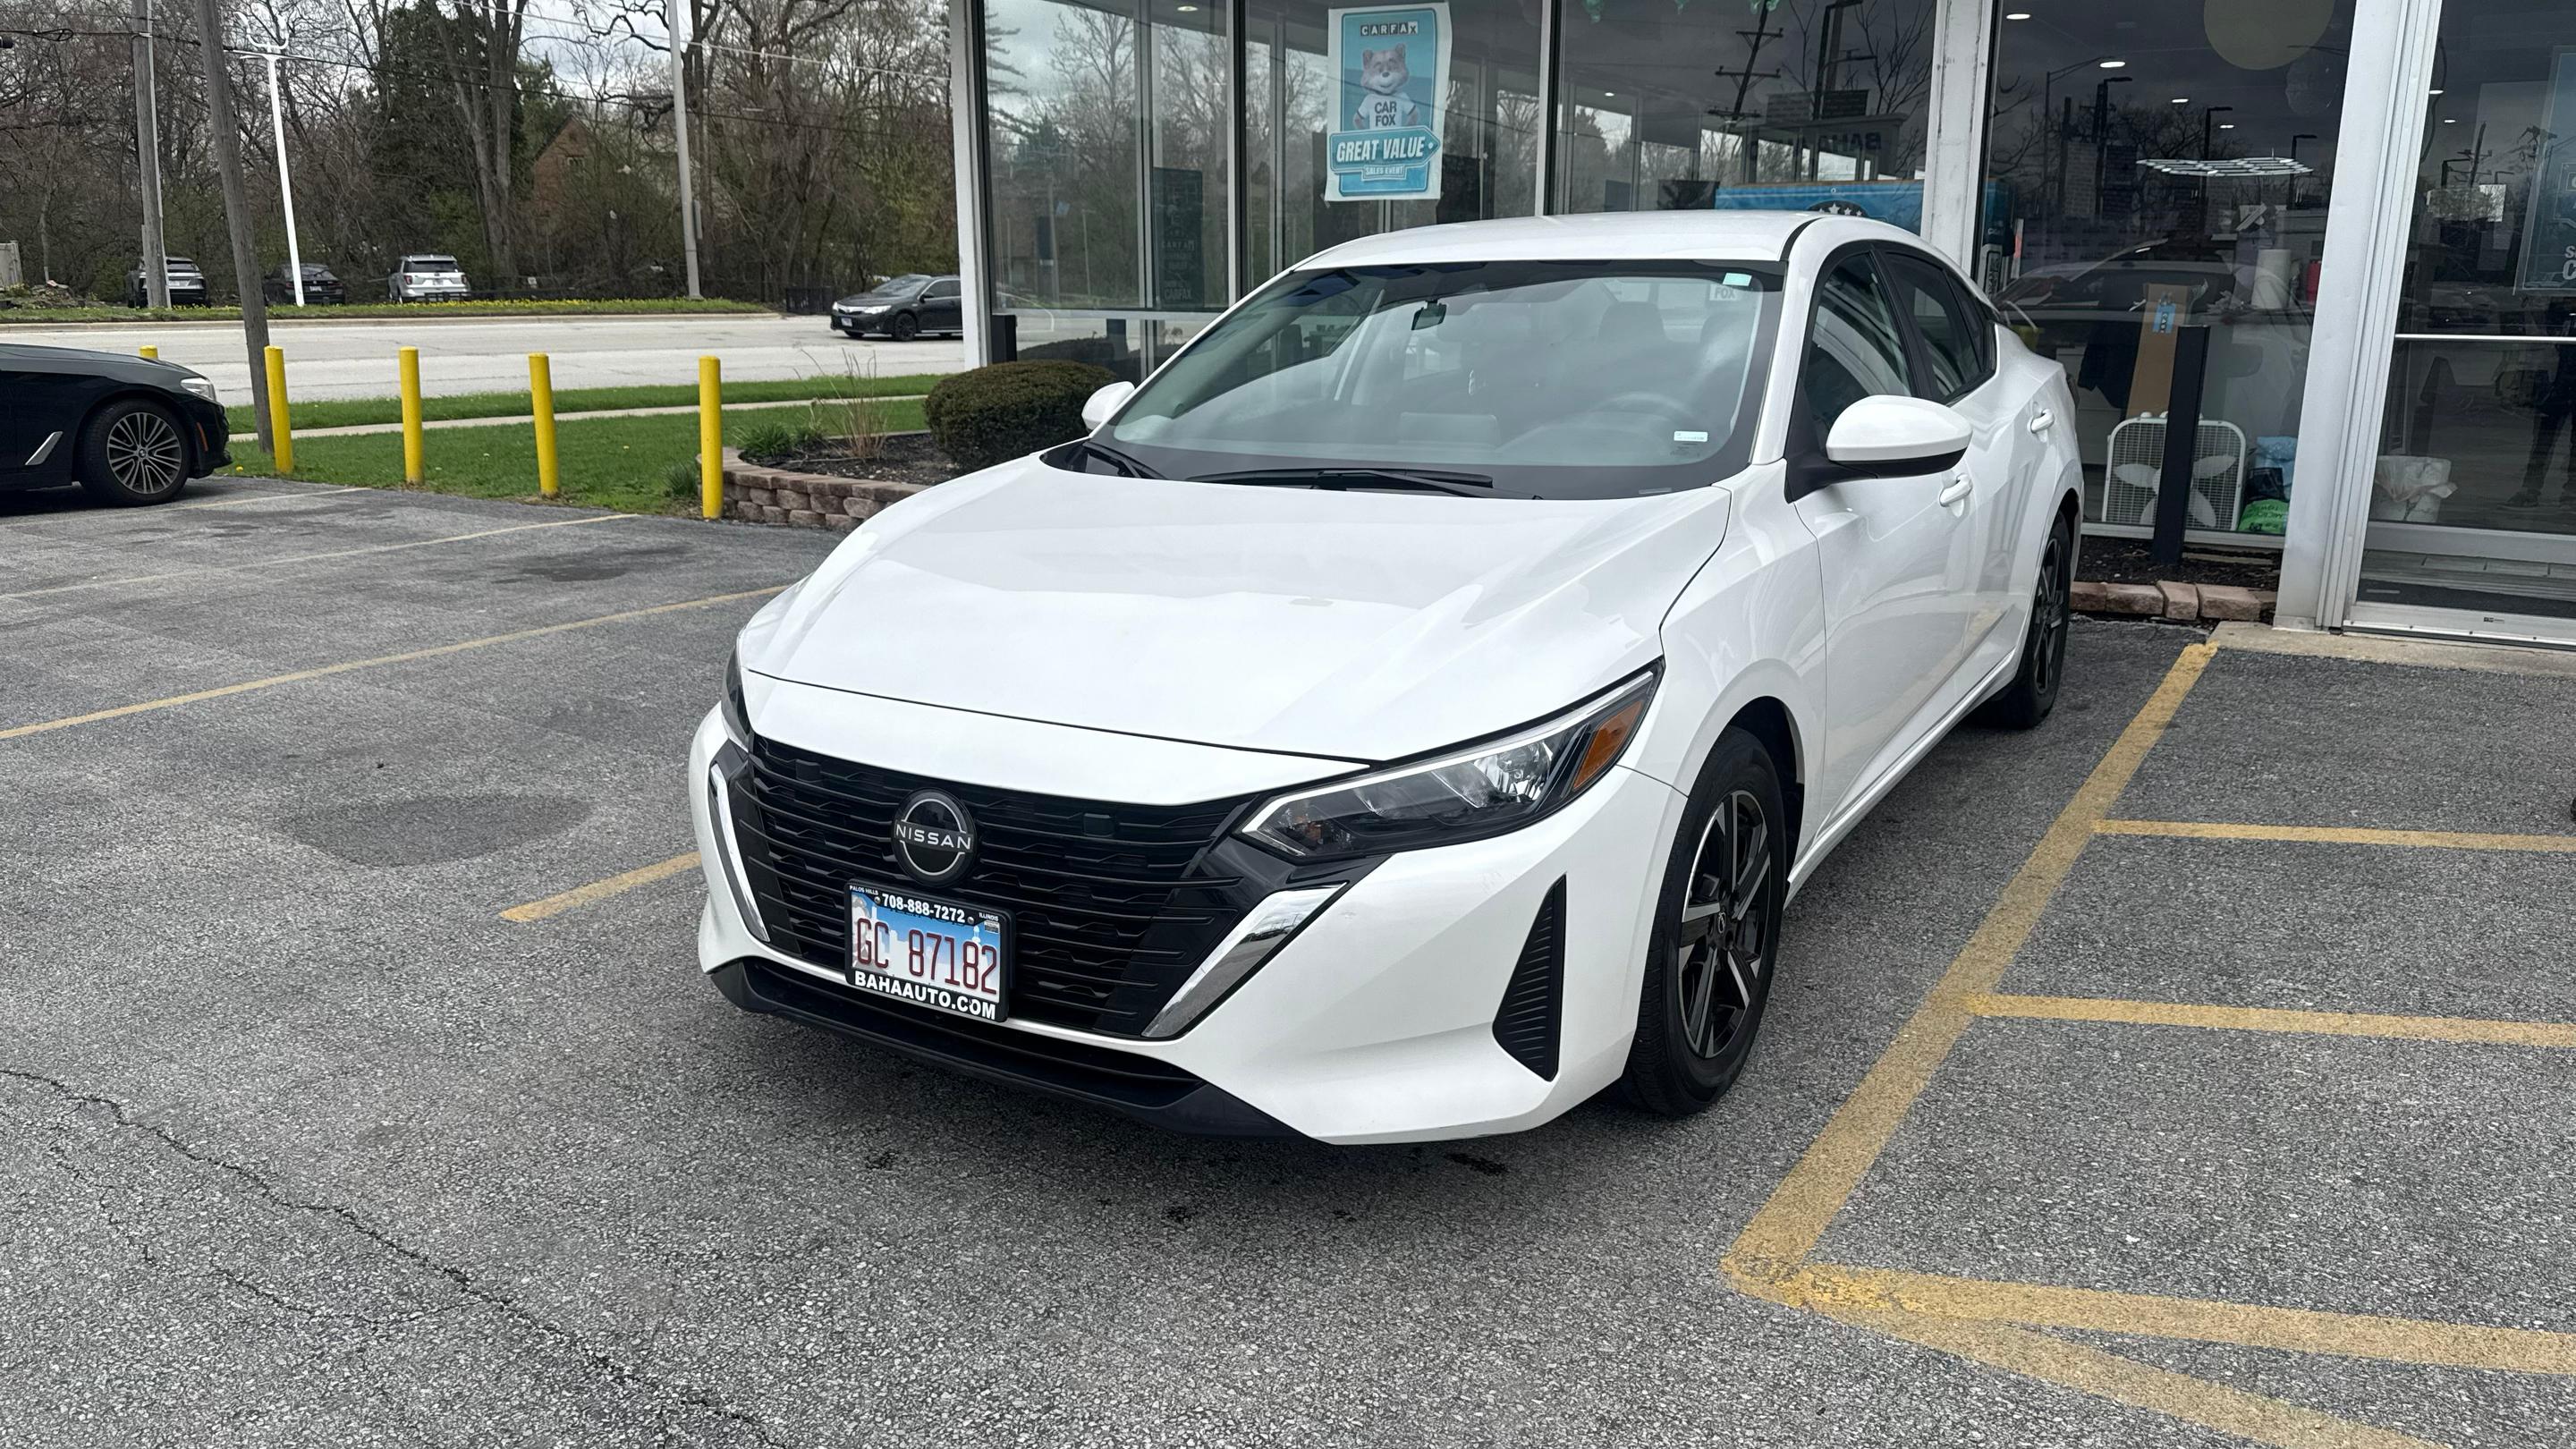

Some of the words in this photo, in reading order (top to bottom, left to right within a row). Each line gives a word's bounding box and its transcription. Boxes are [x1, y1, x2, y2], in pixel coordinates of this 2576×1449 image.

[1360, 21, 1418, 36] CARFAX
[1374, 101, 1397, 114] CAR
[1375, 114, 1396, 127] FOX
[1336, 140, 1379, 163] GREAT
[1383, 136, 1426, 159] VALUE
[1365, 166, 1384, 175] SALES
[1385, 165, 1403, 175] EVENT
[1714, 286, 1736, 299] FOX
[895, 824, 971, 850] NISSAN
[849, 885, 865, 894] PALOS
[865, 888, 879, 896] HILLS
[882, 893, 965, 923] 708-888-7272
[979, 911, 999, 922] ILLINOIS
[857, 918, 889, 969] GC
[909, 928, 997, 995] 87182
[854, 970, 996, 1021] BAHAAUTO.COM
